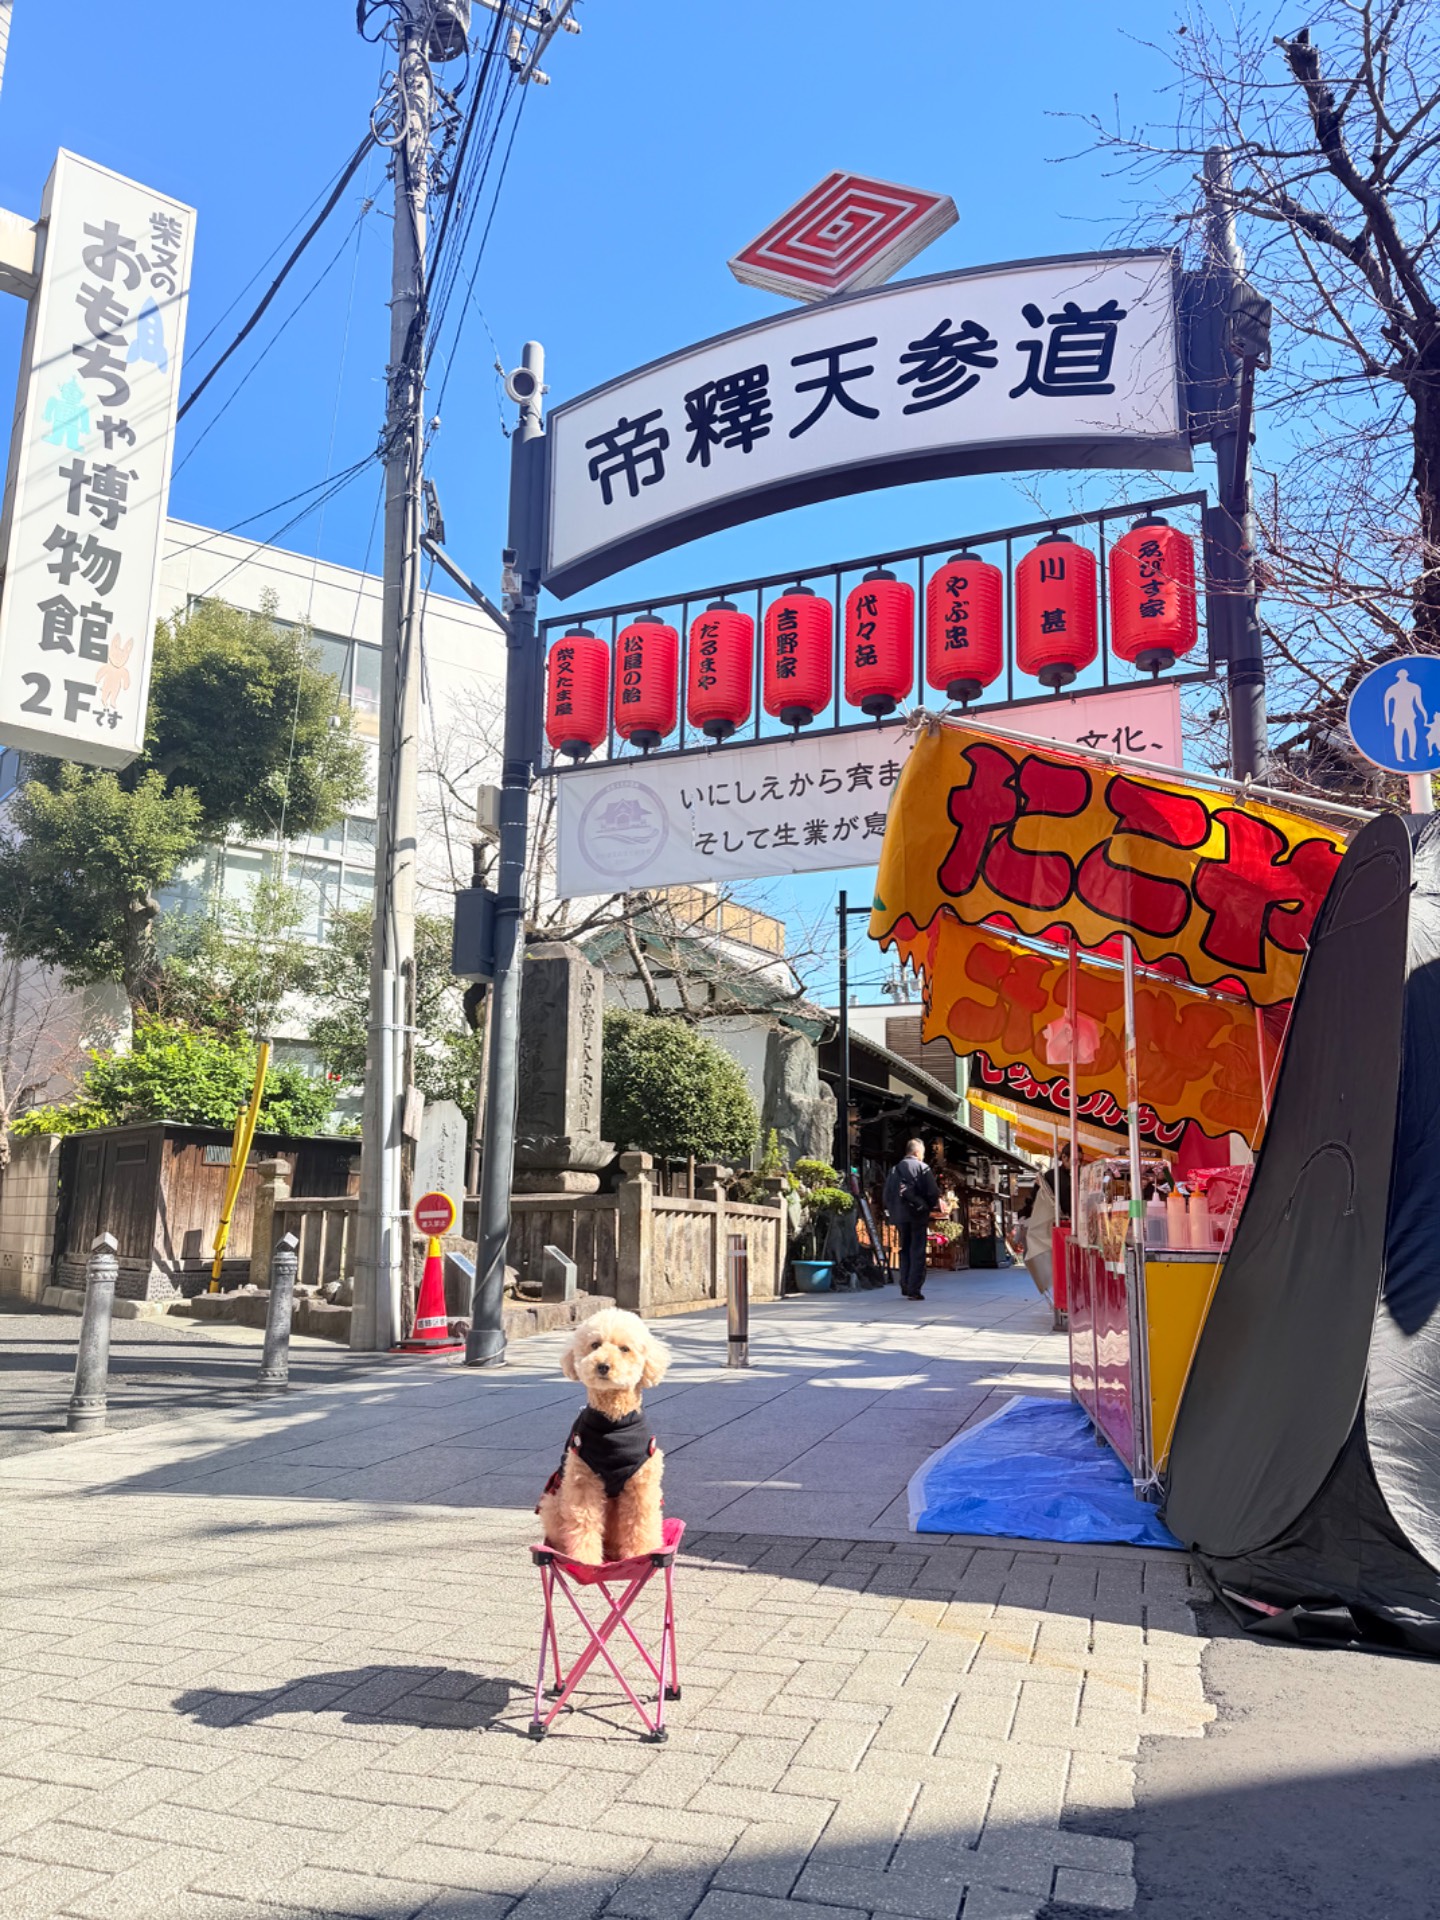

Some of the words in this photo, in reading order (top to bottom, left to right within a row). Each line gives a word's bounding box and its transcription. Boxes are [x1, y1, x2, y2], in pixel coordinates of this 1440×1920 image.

[148, 211, 183, 297] 柴又の
[36, 219, 152, 664] おもちゃ博物館
[944, 575, 970, 652] やぶ忠
[1039, 556, 1067, 635] 川甚
[621, 635, 644, 704] 松屋の飴
[697, 620, 719, 691] だるまや
[775, 607, 798, 679] 吉野家
[553, 647, 575, 717] 柴又たま屋
